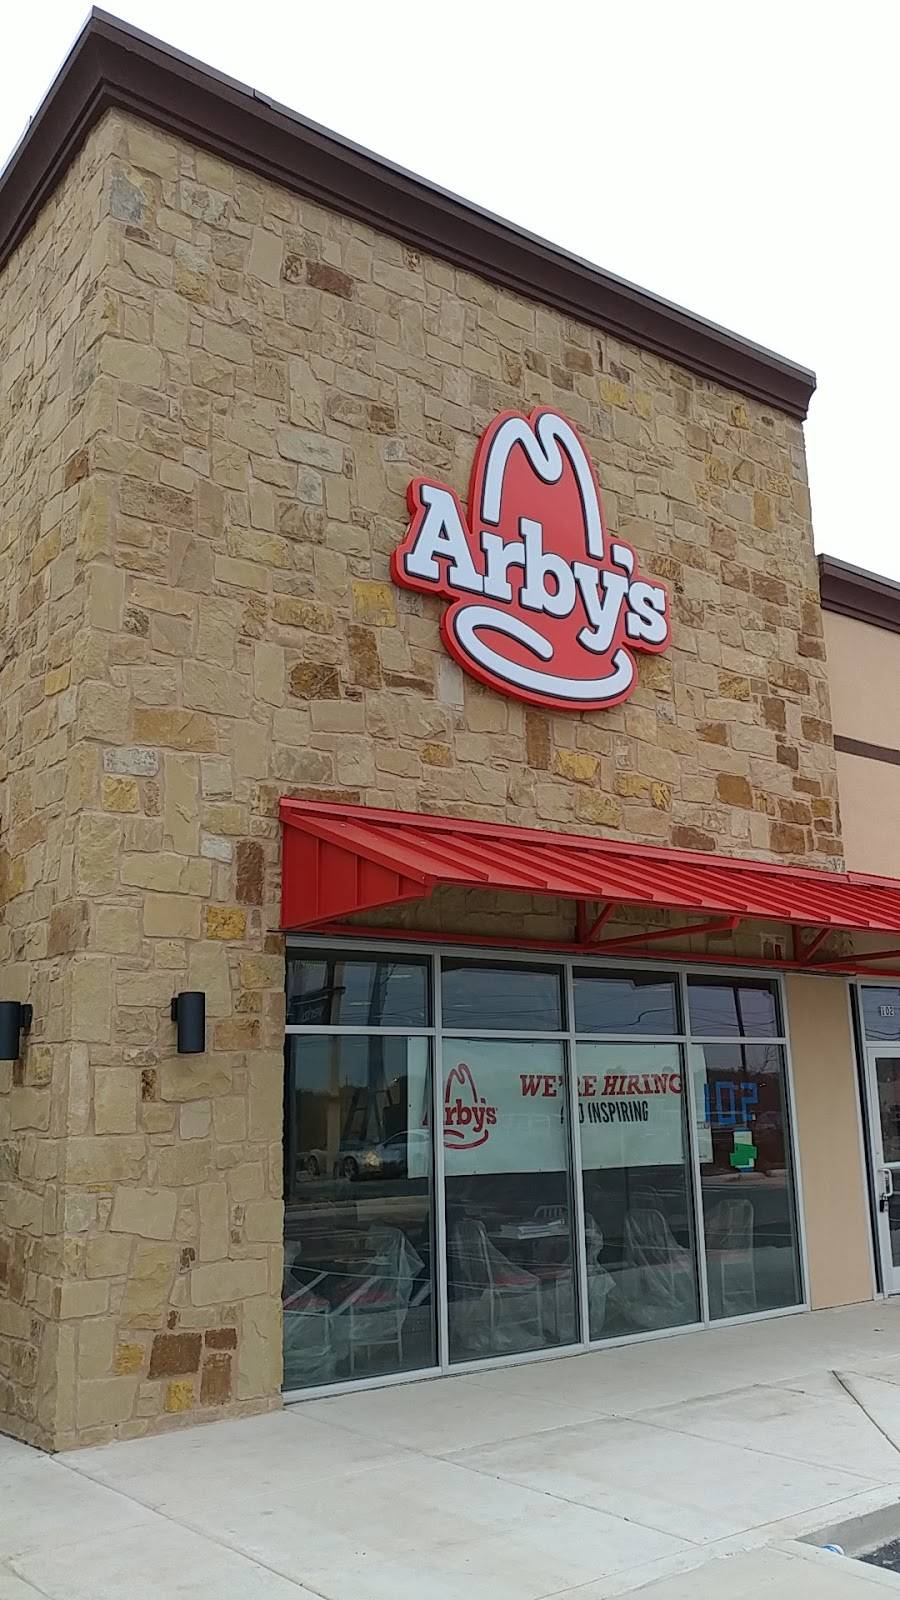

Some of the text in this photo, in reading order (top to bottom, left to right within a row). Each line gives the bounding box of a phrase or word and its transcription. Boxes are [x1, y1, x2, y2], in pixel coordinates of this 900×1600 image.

[405, 484, 668, 654] Arby's
[880, 1005, 895, 1017] 102
[601, 1073, 682, 1096] HIRING
[422, 1097, 497, 1133] rby's
[588, 1100, 649, 1124] INSPIRING
[704, 1081, 758, 1122] 102
